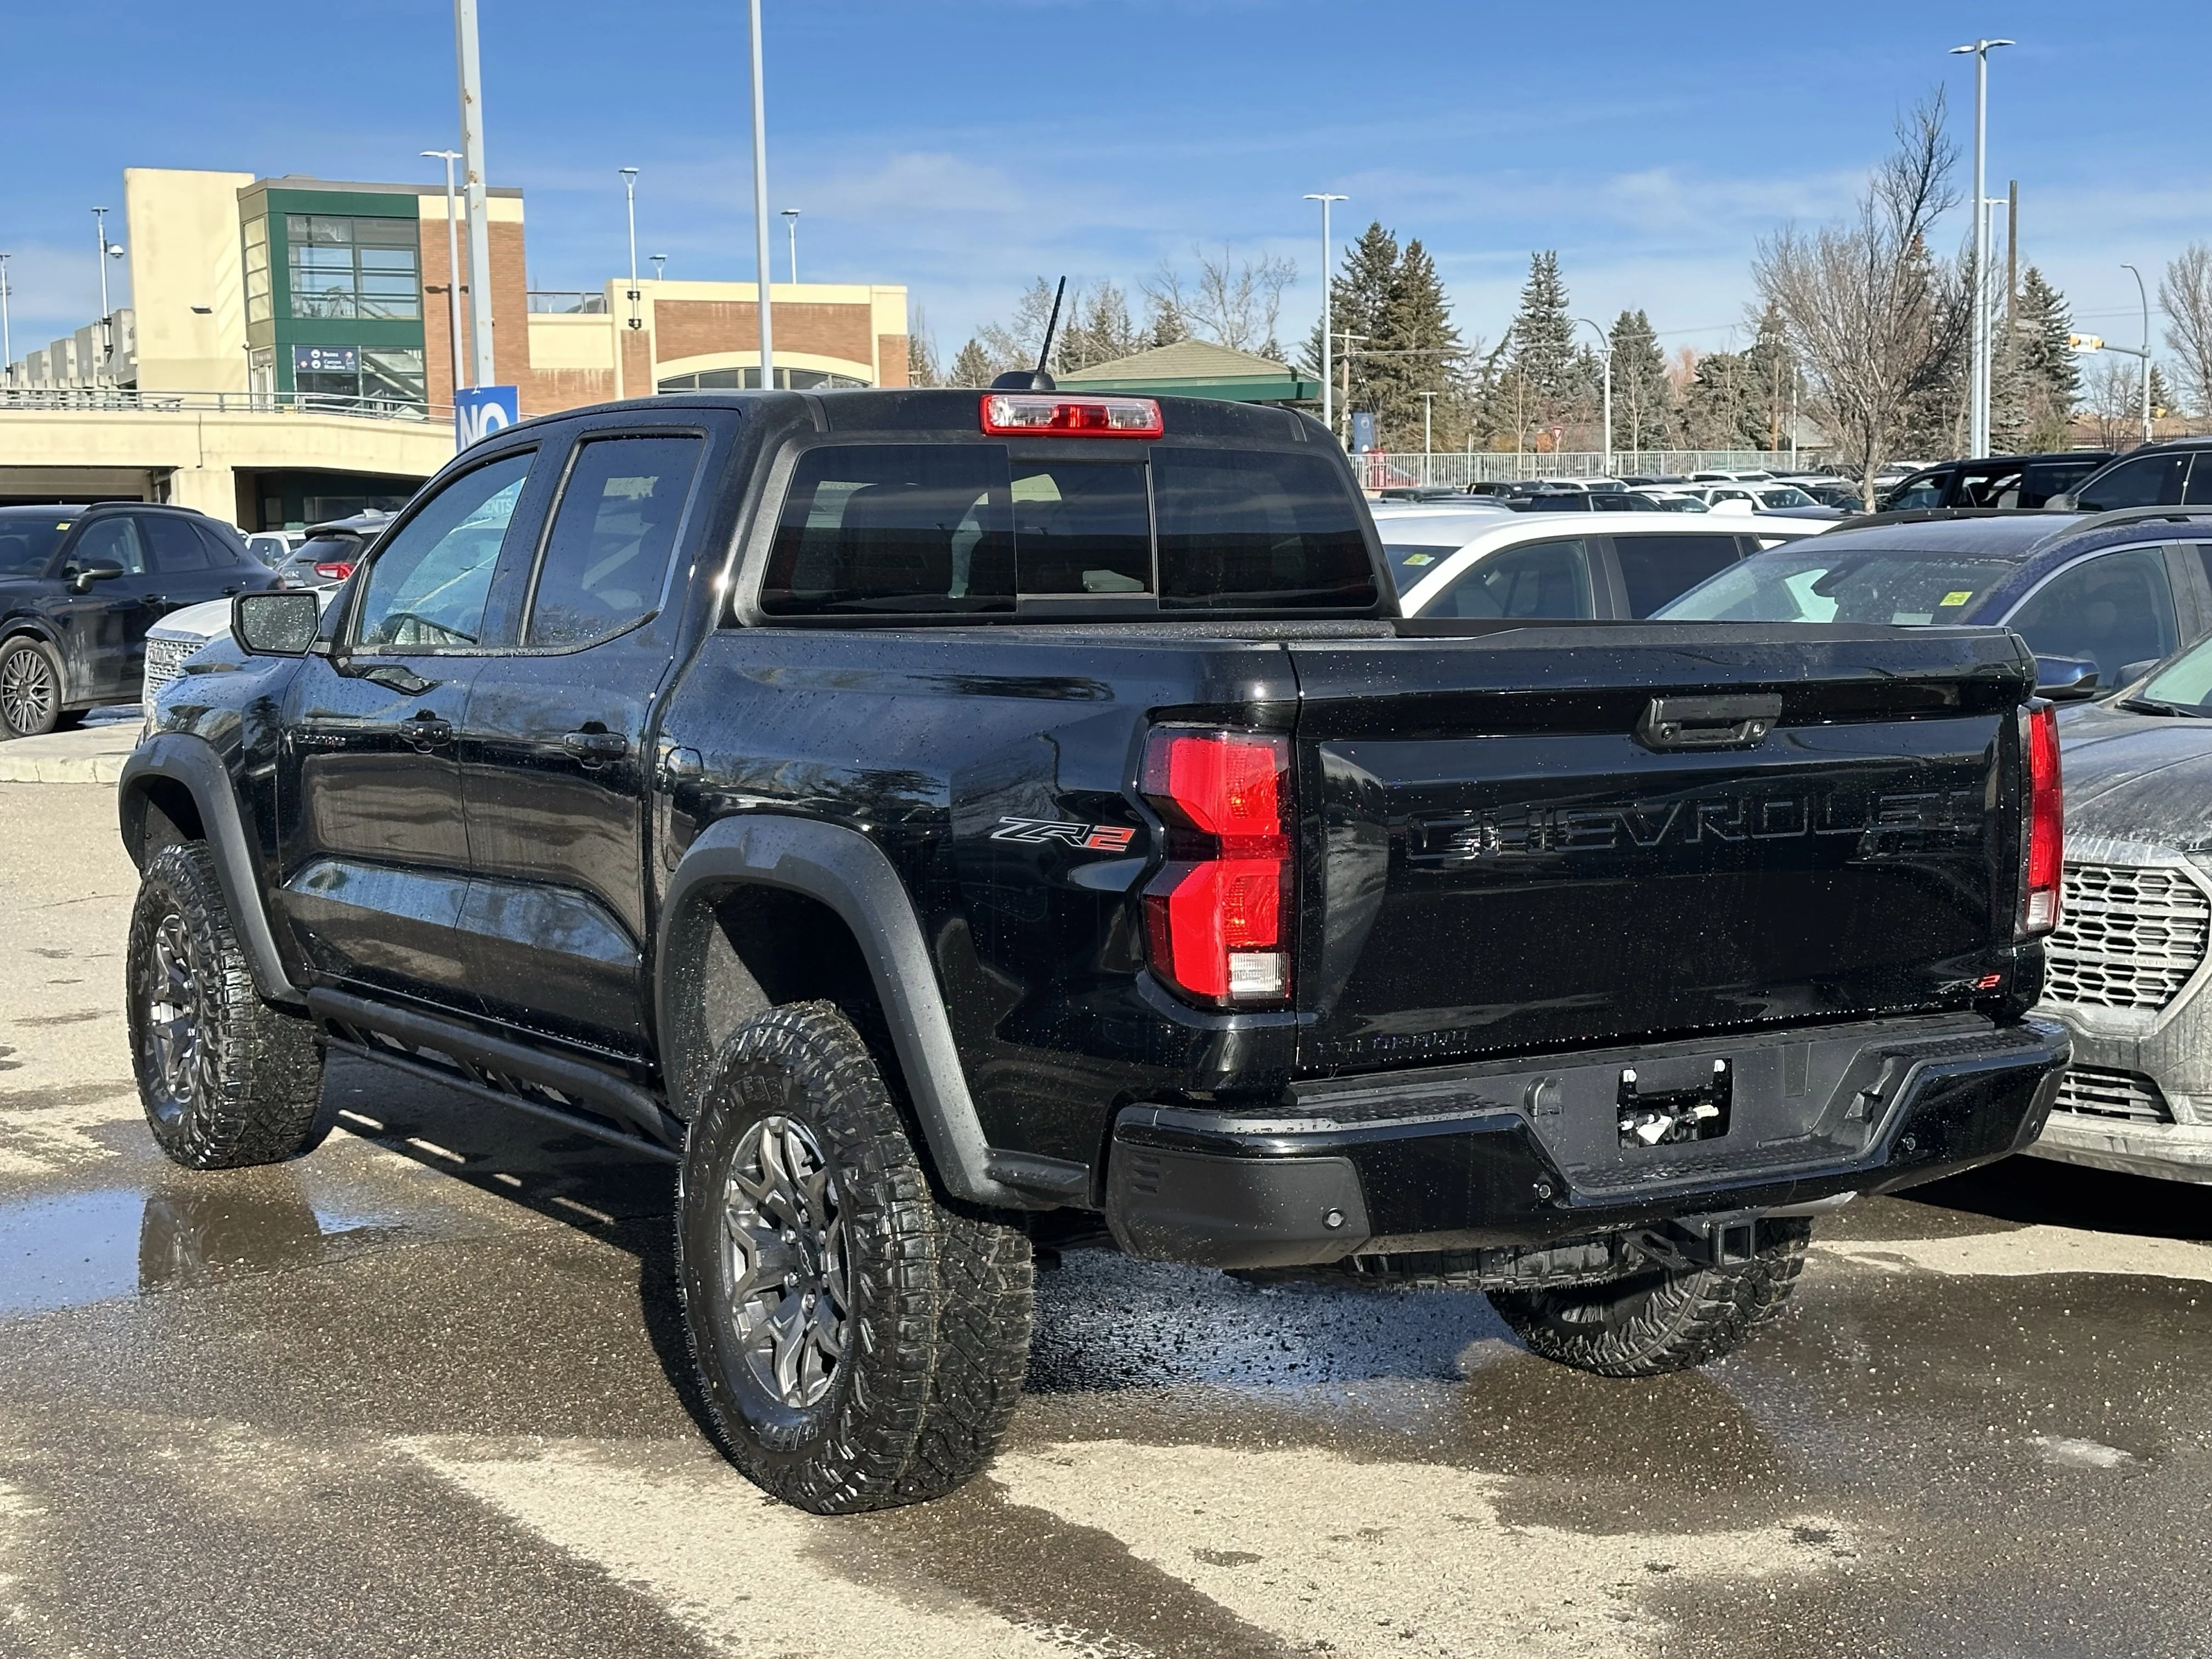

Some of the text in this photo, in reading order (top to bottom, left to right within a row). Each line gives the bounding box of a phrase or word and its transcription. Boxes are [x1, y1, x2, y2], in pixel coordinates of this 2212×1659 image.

[459, 402, 510, 451] NO
[990, 816, 1137, 851] ZR2
[1406, 782, 1973, 860] CHEVROLET
